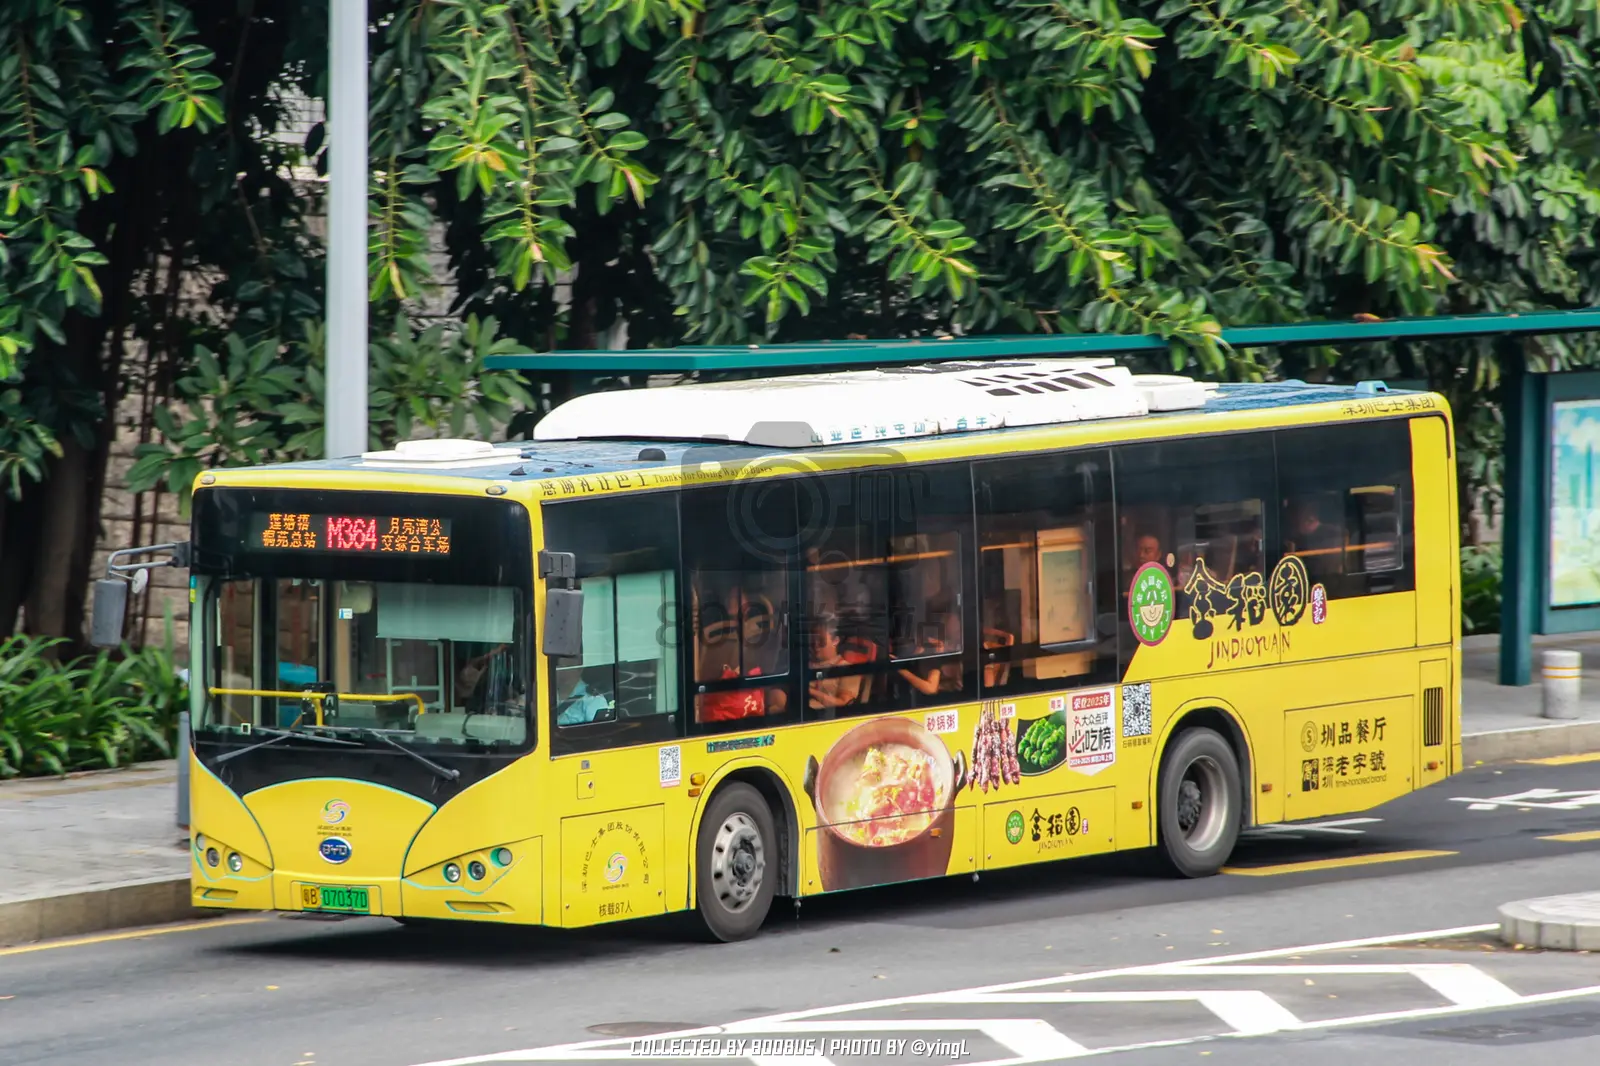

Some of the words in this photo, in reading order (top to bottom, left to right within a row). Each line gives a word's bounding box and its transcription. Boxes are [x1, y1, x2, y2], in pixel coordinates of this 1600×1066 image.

[1342, 397, 1436, 416] 深圳巴士集团
[540, 472, 652, 497] 感谢礼让巴士
[653, 473, 682, 484] Thanks
[683, 471, 696, 481] for
[327, 516, 378, 550] M364
[389, 517, 443, 537] 月亮湾公
[380, 534, 450, 554] 交综合车场
[926, 713, 956, 732] 砂锅粥
[1081, 711, 1109, 727] 大众点评
[1068, 726, 1111, 754] 必吃榜
[1321, 716, 1387, 747] 圳品餐厅
[322, 843, 348, 856] BYD
[598, 900, 633, 917] 核载87人
